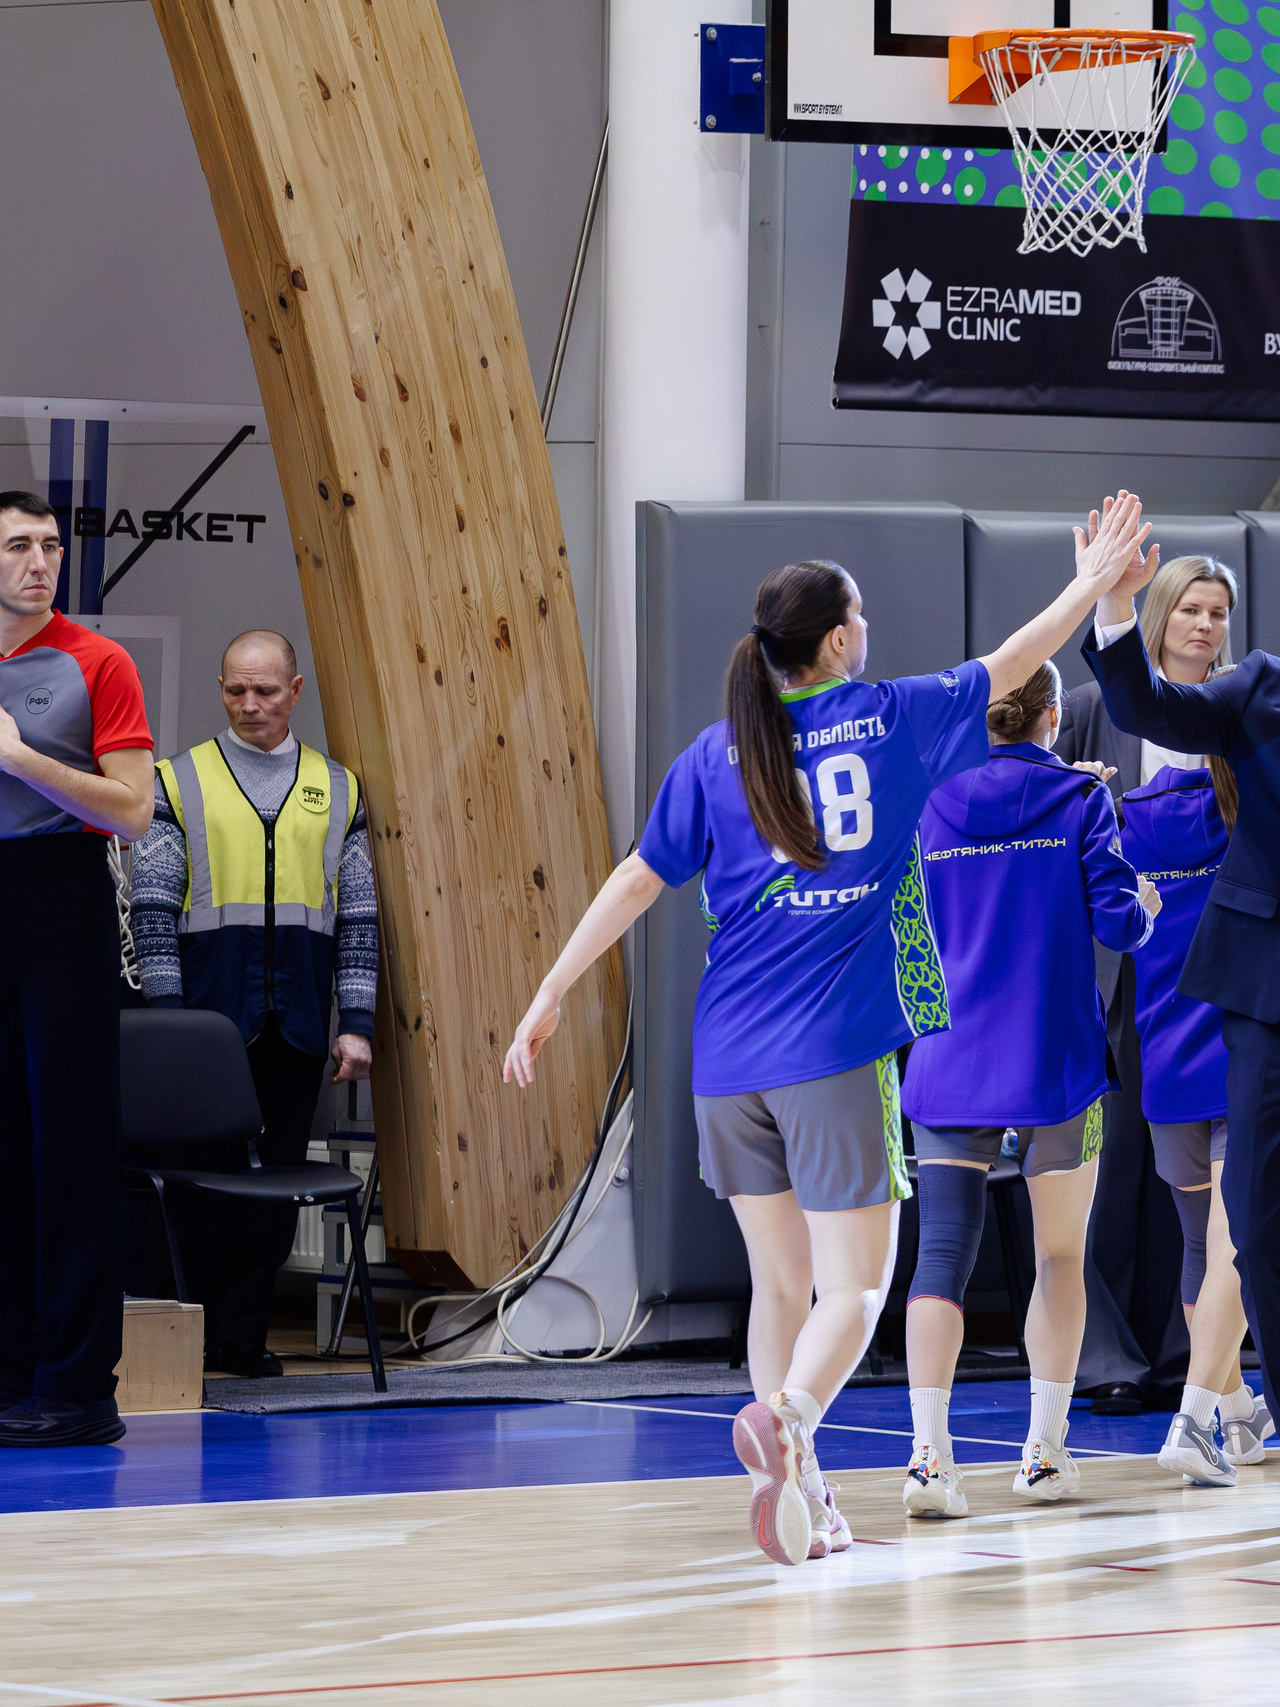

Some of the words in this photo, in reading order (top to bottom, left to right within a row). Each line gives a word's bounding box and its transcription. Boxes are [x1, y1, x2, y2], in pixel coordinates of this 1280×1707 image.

[946, 285, 1082, 316] EZRAMED
[947, 315, 1021, 342] CLINIC
[74, 507, 267, 544] BASKET
[806, 716, 887, 749] ОБЛАСТЬ
